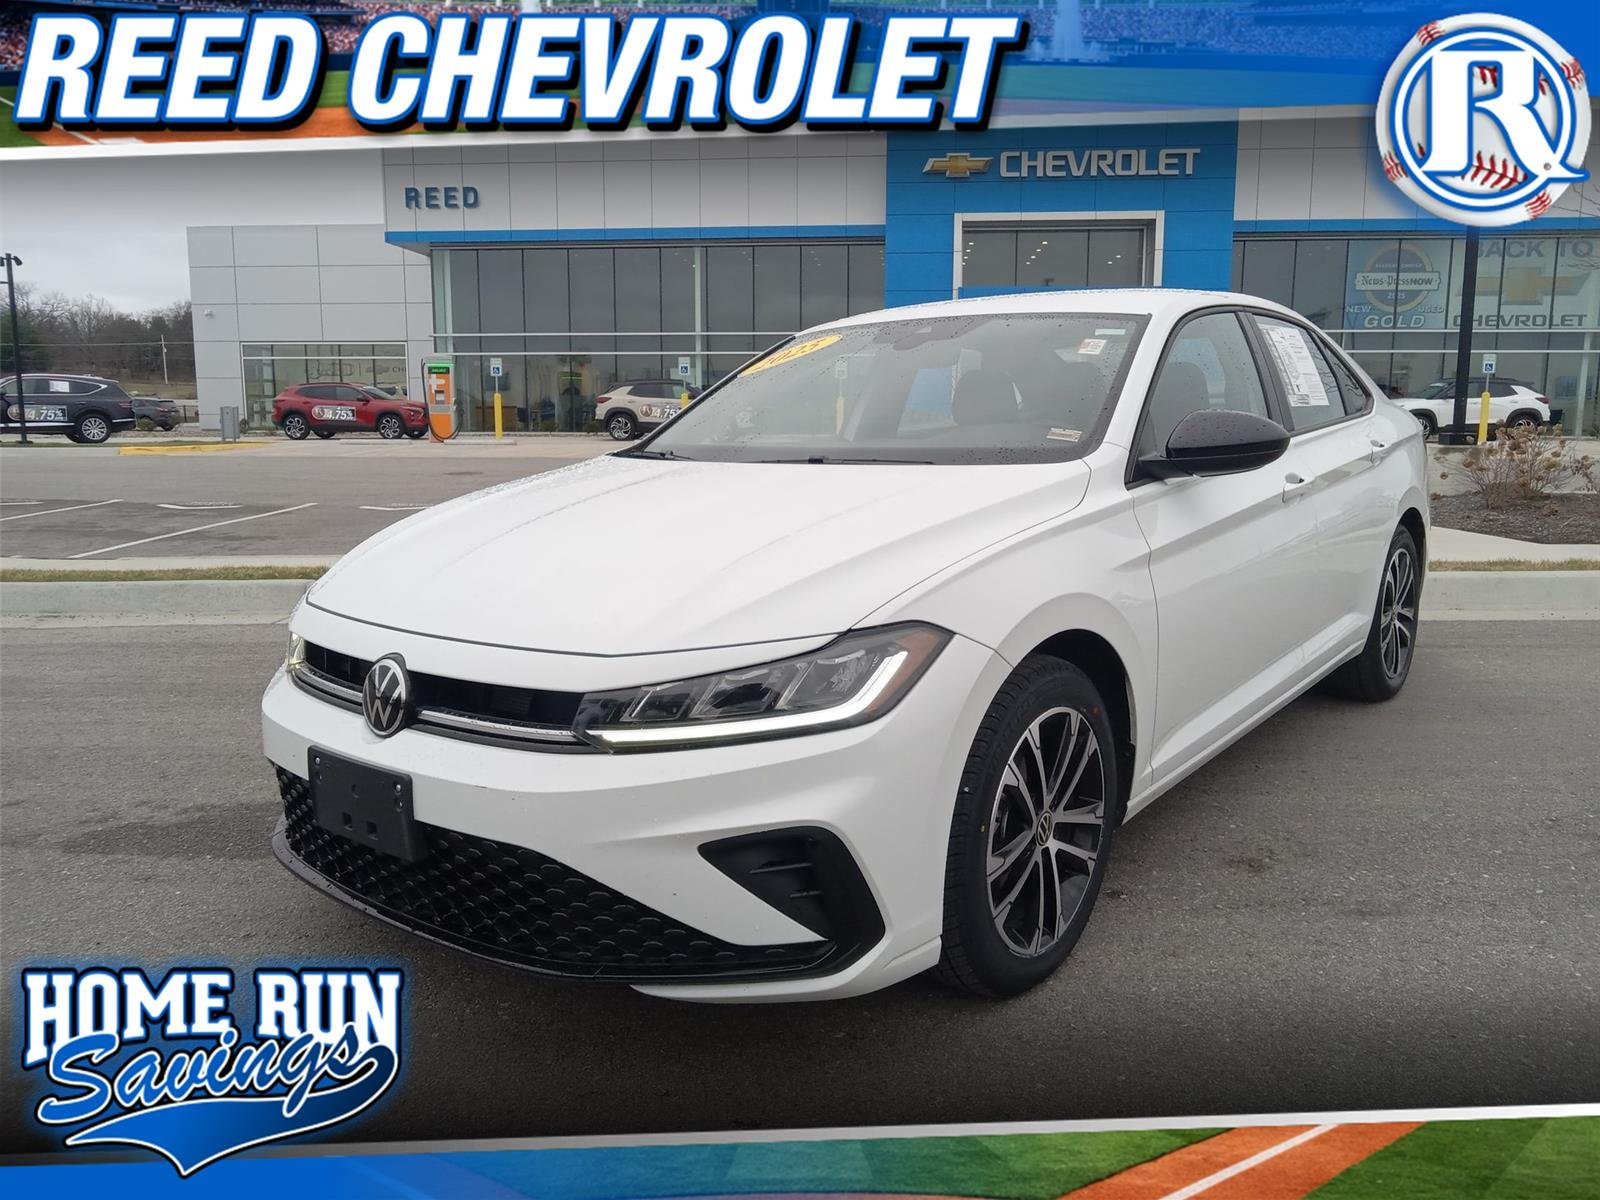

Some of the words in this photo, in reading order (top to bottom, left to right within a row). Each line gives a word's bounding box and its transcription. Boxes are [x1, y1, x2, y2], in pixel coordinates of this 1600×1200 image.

[1000, 149, 1200, 177] CHEVROLET
[405, 187, 480, 209] REED
[1478, 240, 1544, 257] ACK
[1345, 304, 1371, 313] NEW
[1364, 315, 1425, 328] GOLD
